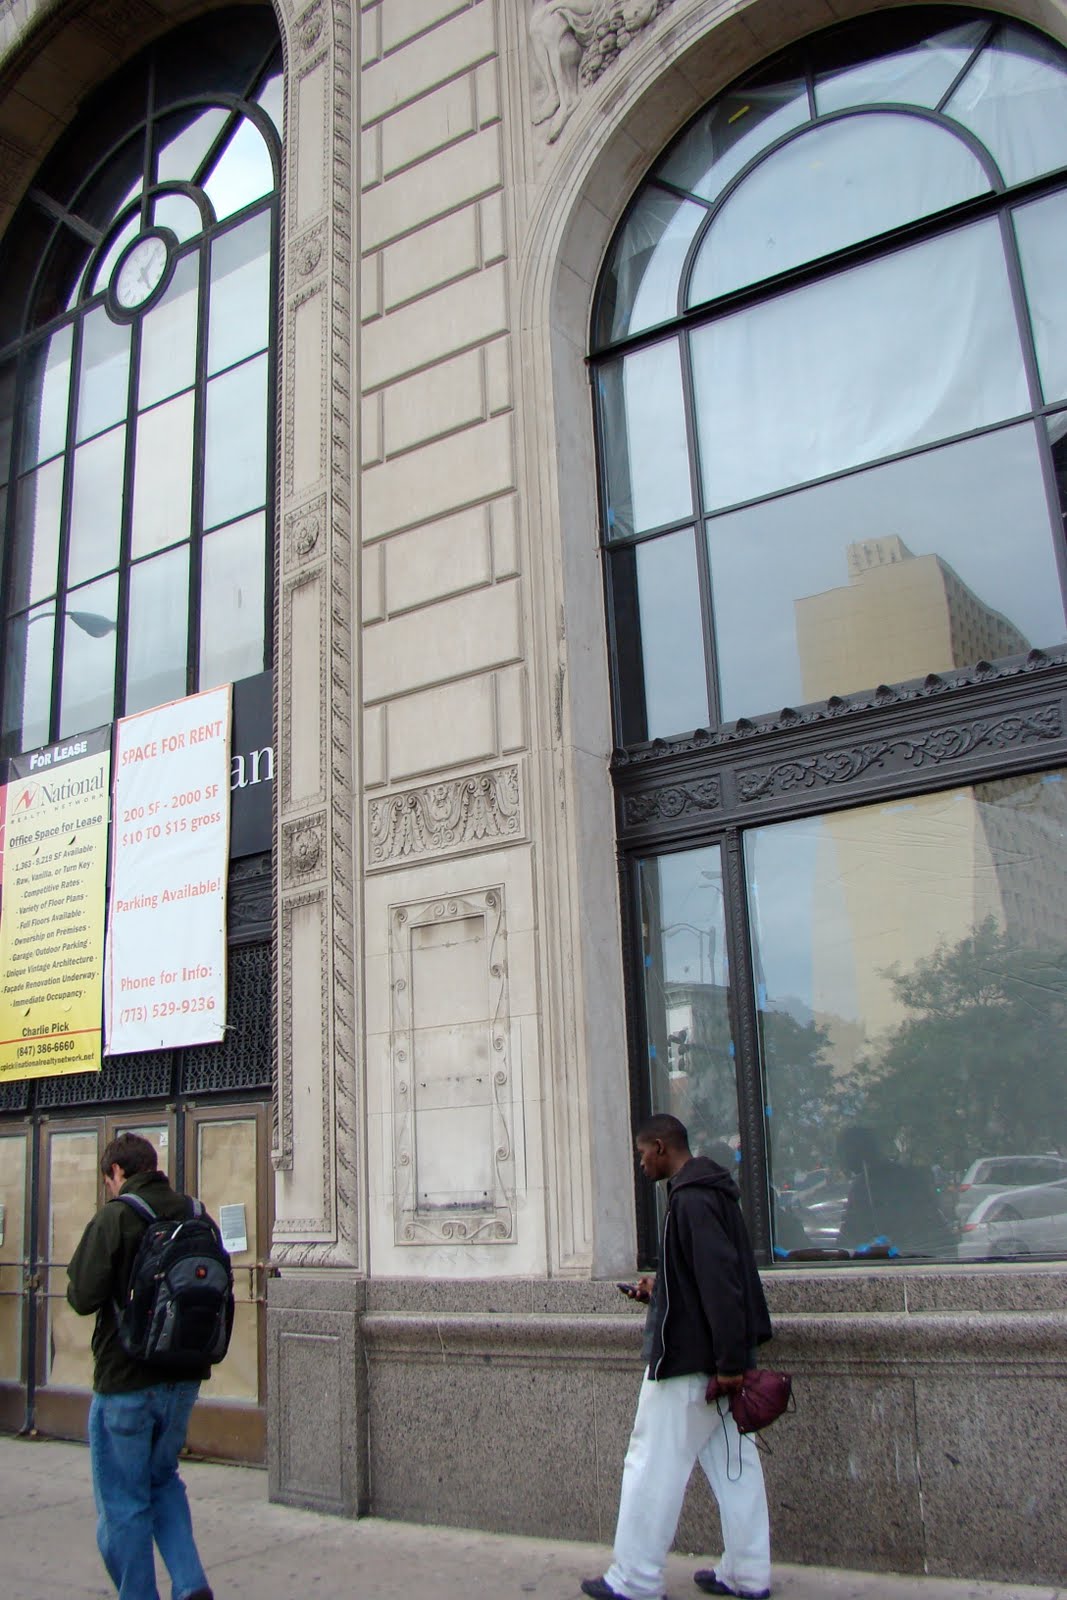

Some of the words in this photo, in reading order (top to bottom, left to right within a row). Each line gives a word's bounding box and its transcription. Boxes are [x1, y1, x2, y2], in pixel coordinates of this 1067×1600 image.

[122, 742, 157, 766] SPACE
[162, 733, 185, 754] FOR
[190, 720, 222, 744] RENT
[42, 767, 104, 806] National
[11, 811, 46, 824] REALTY
[55, 794, 104, 811] NETWORK
[124, 806, 144, 822] 200
[148, 801, 160, 816] SF
[172, 790, 201, 808] 2000
[205, 784, 218, 799] SF
[10, 834, 32, 848] Office
[35, 826, 59, 840] Space
[62, 822, 74, 832] for
[76, 815, 102, 828] Lease
[122, 832, 142, 846] $10
[146, 825, 160, 840] TO
[166, 818, 187, 835] $15
[191, 812, 221, 832] gross
[54, 852, 62, 860] SF
[63, 844, 93, 858] Available
[64, 864, 78, 873] Turn
[78, 861, 90, 870] Key
[24, 884, 59, 898] Competitive
[61, 879, 80, 888] Rates
[116, 895, 158, 913] Parking
[162, 877, 221, 903] Available!
[19, 903, 39, 914] Variety
[40, 900, 48, 909] of
[48, 898, 65, 908] Floor
[66, 894, 84, 903] Plans
[20, 921, 30, 929] Full
[32, 917, 50, 926] Floors
[52, 909, 82, 923] Available
[14, 932, 45, 946] Ownership
[56, 925, 87, 937] Premises
[62, 939, 88, 951] Parking
[7, 968, 26, 978] Unique
[28, 962, 50, 973] Vintage
[52, 955, 94, 968] Architecture
[26, 976, 60, 989] Renovation
[62, 971, 96, 983] Underway
[121, 975, 155, 992] Phone
[160, 970, 178, 984] for
[182, 964, 212, 981] Info:
[13, 994, 45, 1007] Immediate
[46, 990, 83, 1001] Occupancy
[119, 1006, 147, 1026] (773)
[152, 996, 215, 1018] 529-9236
[22, 1024, 49, 1037] Charlie
[52, 1022, 70, 1033] Pick
[17, 1046, 35, 1058] (847)
[37, 1040, 75, 1054] 386-6660
